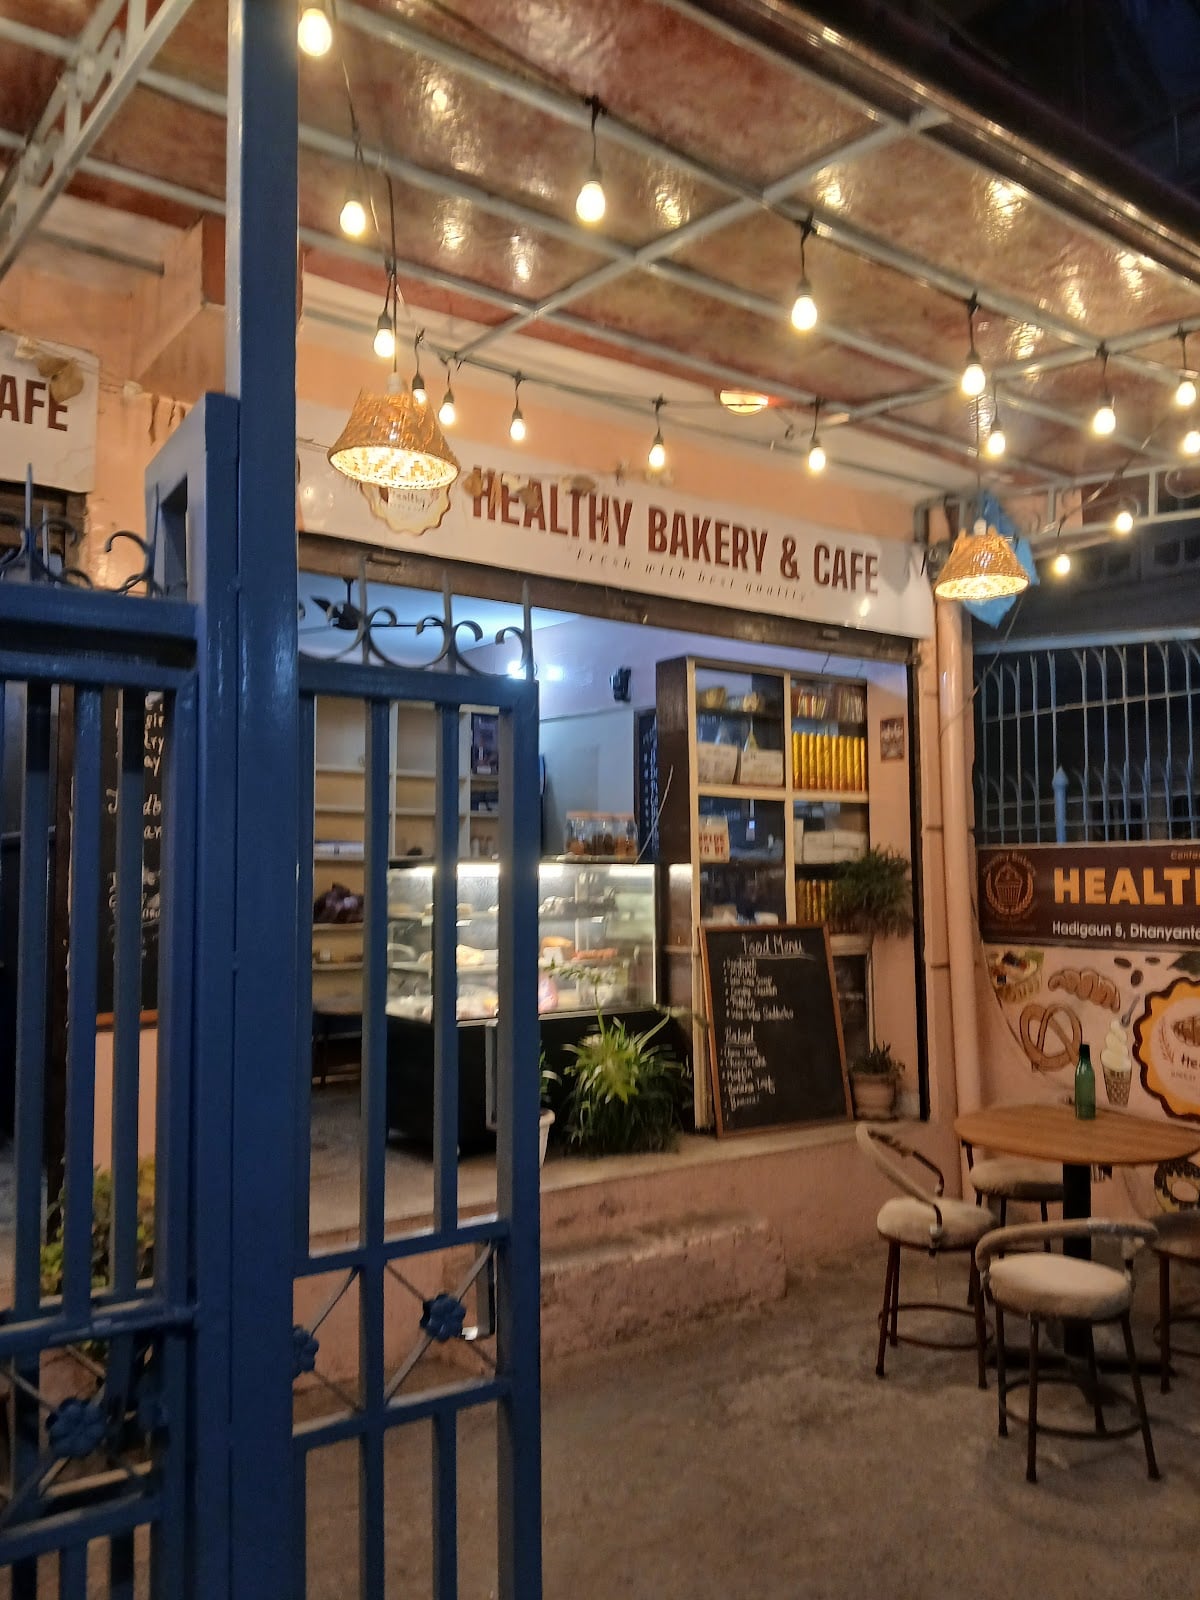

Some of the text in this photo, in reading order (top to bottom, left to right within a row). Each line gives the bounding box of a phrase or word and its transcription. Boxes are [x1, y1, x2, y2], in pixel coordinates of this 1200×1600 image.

[472, 465, 879, 596] HEALTHY BAKERY & CAFE
[1052, 920, 1112, 939] Hadigaun
[773, 934, 803, 955] Menu
[1180, 1052, 1200, 1070] He
